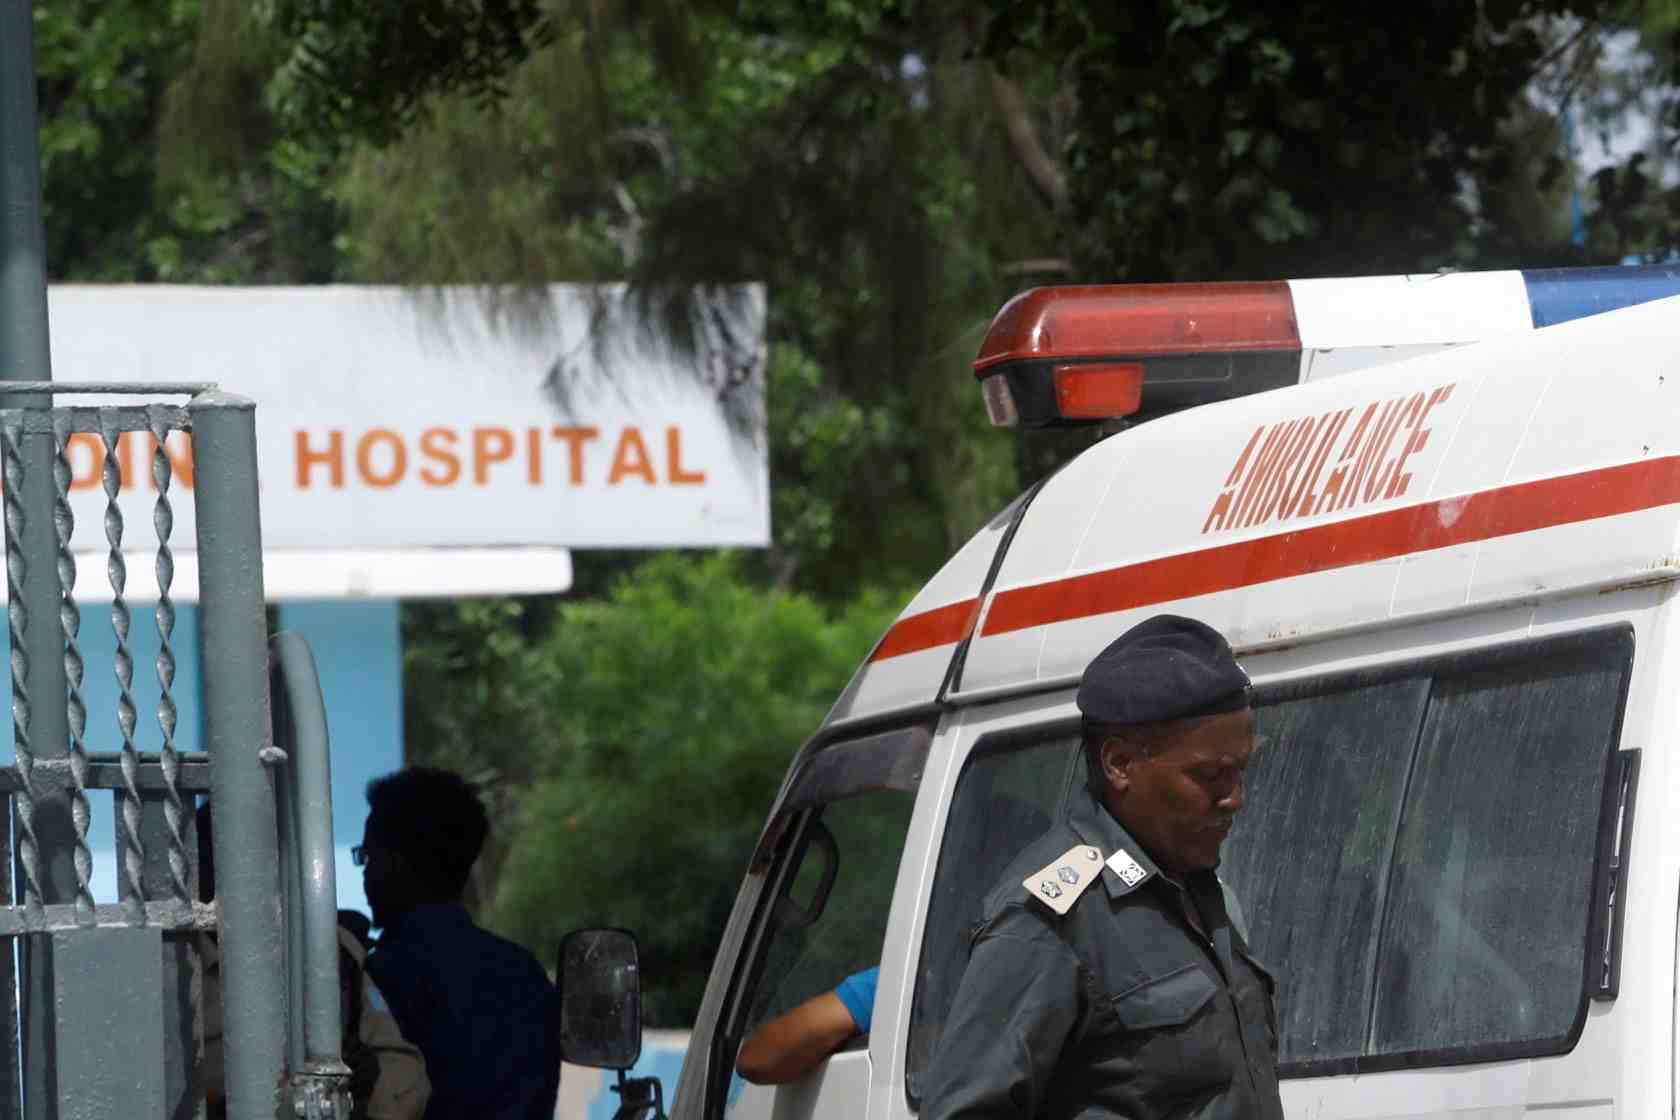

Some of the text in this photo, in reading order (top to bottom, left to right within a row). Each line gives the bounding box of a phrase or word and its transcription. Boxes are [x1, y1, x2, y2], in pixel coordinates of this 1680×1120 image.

[63, 426, 708, 490] DIN HOSPITAL
[1201, 383, 1456, 534] AMBULANCE
